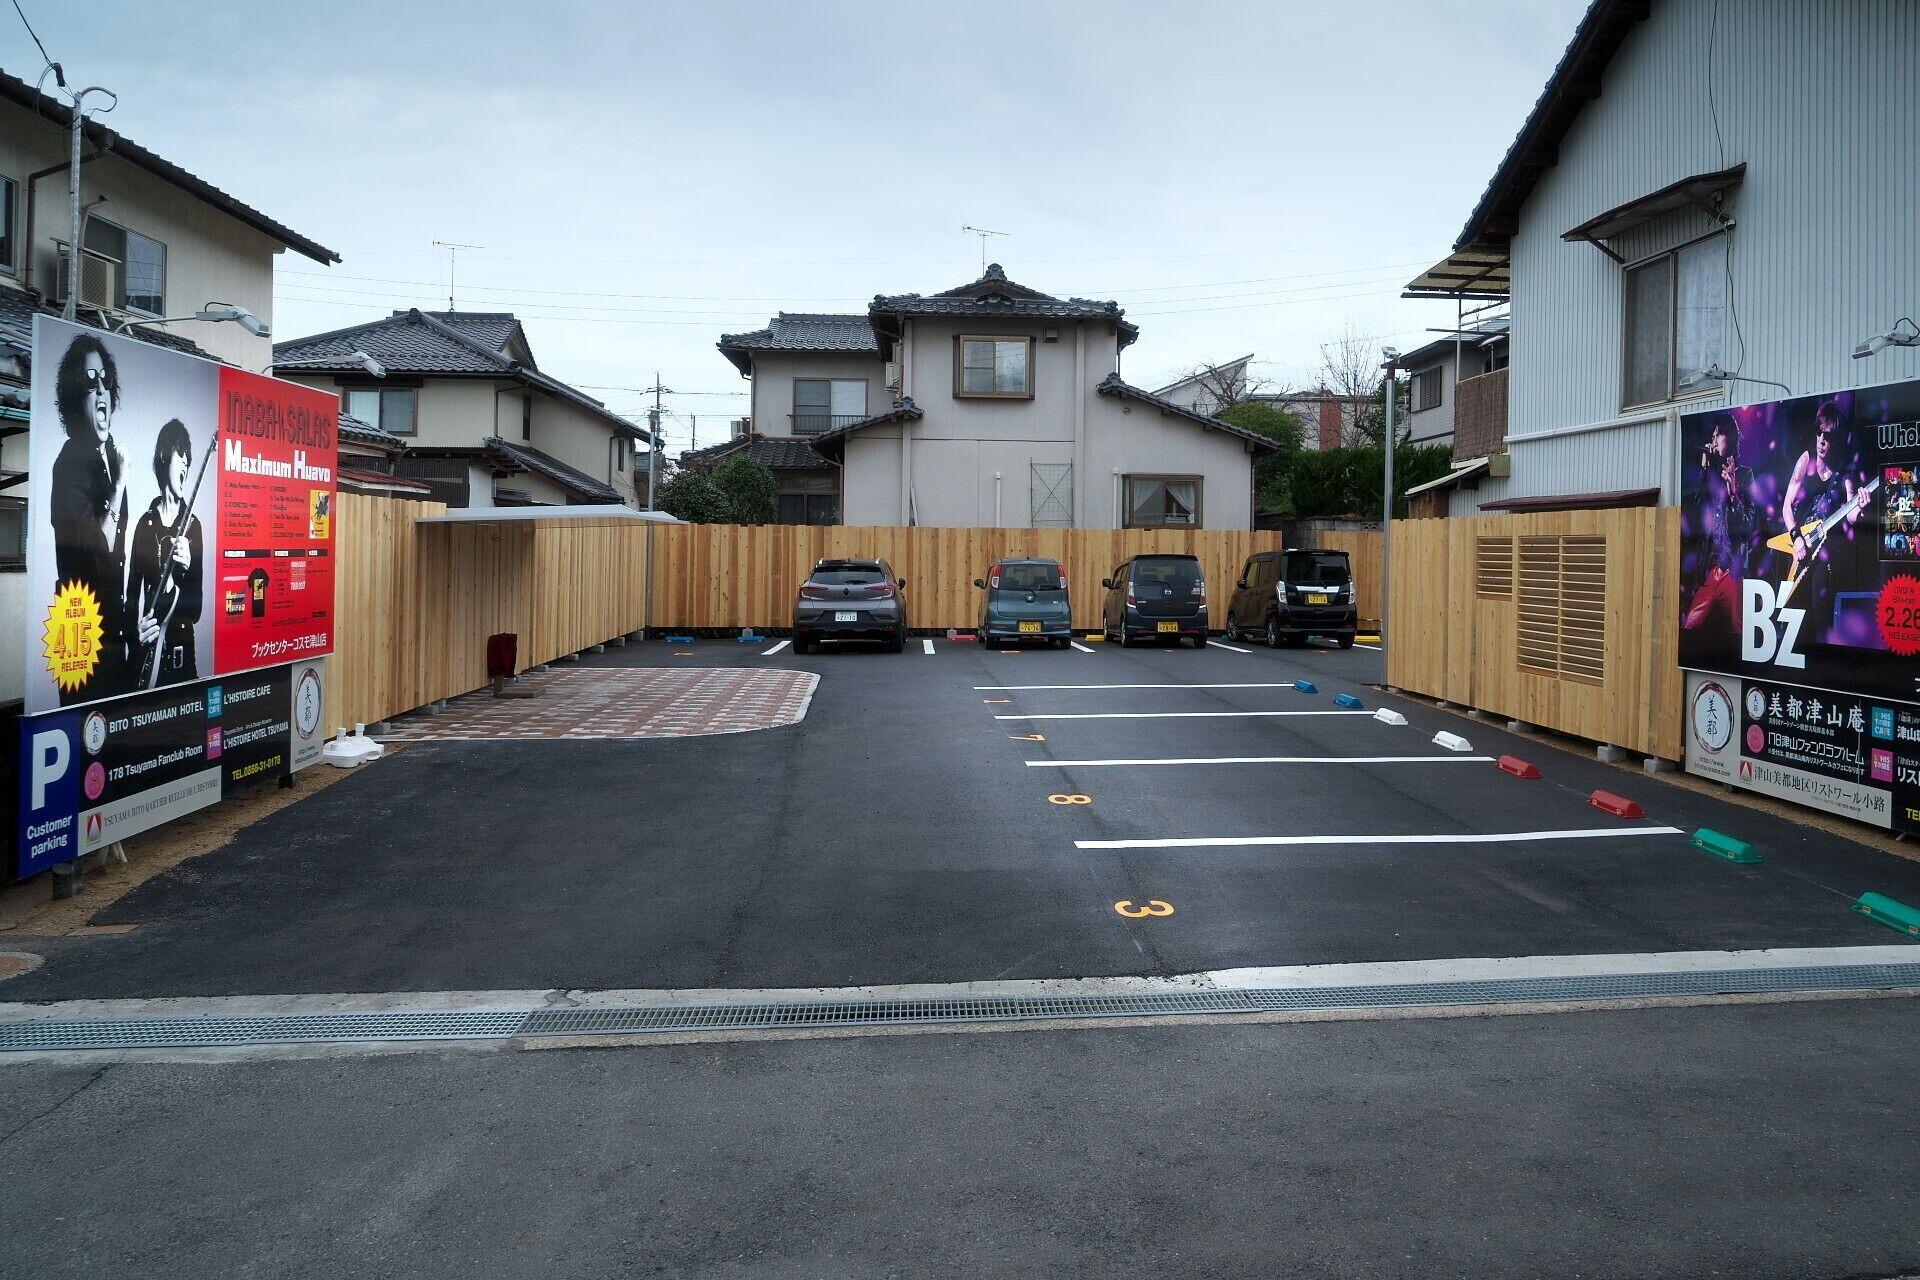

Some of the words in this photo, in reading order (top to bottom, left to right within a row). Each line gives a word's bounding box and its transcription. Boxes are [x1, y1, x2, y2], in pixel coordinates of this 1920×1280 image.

[225, 438, 292, 478] Maximum
[294, 449, 331, 483] Huavo
[66, 607, 86, 618] ALBUM
[69, 597, 82, 607] NEW
[1742, 579, 1807, 669] B'z
[53, 620, 91, 659] 4.15
[251, 633, 327, 659] ブックセンターコスモ津山店
[62, 660, 87, 672] RELEASE
[256, 684, 271, 697] CAFE
[109, 718, 129, 733] BITO
[132, 707, 177, 728] TSUYAMAAN
[180, 701, 204, 715] HOTEL
[1768, 692, 1866, 733] 美都津山庵
[32, 728, 71, 811] P
[109, 766, 124, 781] 178
[125, 758, 157, 776] Tsuyama
[158, 748, 184, 766] Fanclub
[185, 745, 203, 758] Room
[1048, 794, 1092, 805] 8
[1755, 766, 1885, 812] 津山美都地区リストワール小路
[27, 815, 73, 840] Customer
[31, 834, 68, 859] parking
[1114, 900, 1175, 918] 3
